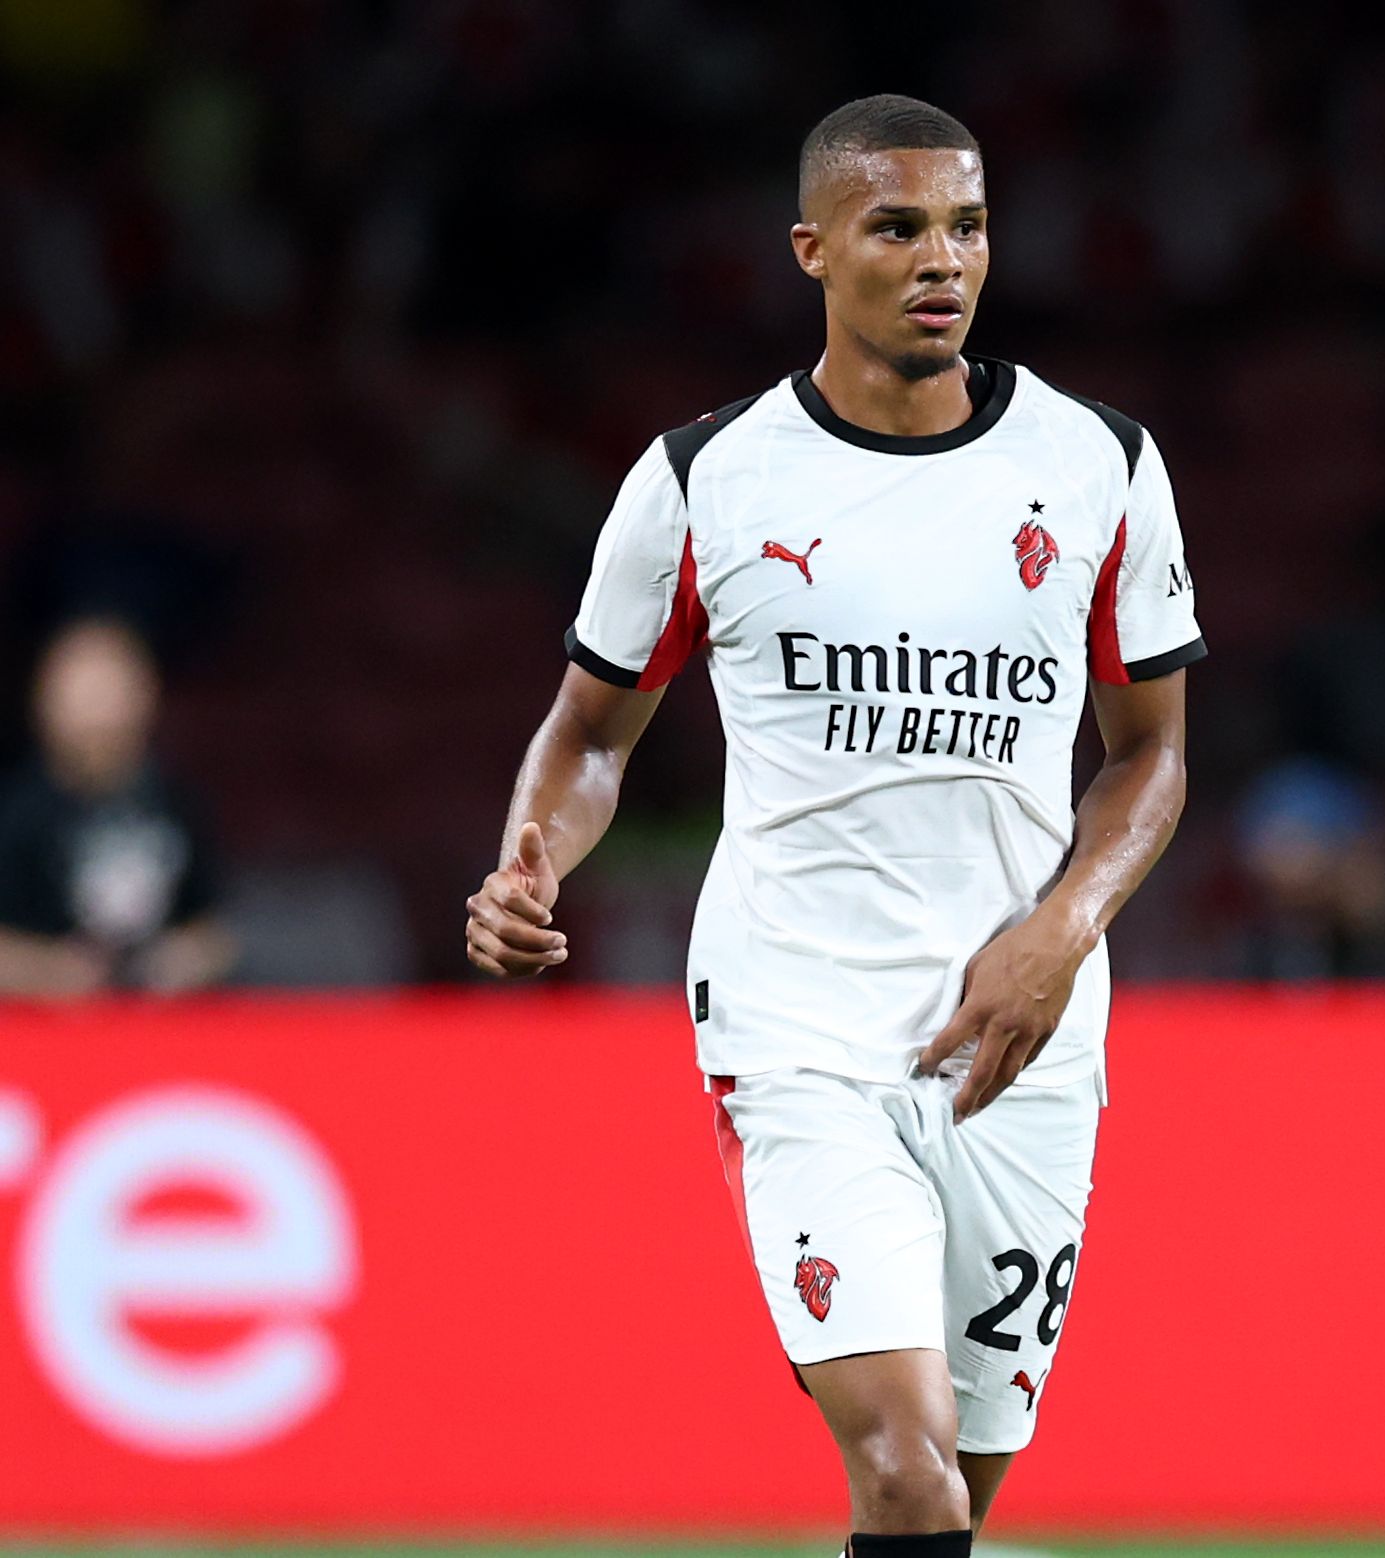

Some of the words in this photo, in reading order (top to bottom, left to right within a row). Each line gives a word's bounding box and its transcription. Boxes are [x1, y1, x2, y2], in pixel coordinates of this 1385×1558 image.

[776, 632, 1059, 704] Emirates
[824, 704, 885, 753] FLY
[896, 707, 1021, 763] BETTER
[964, 1243, 1076, 1352] 28
